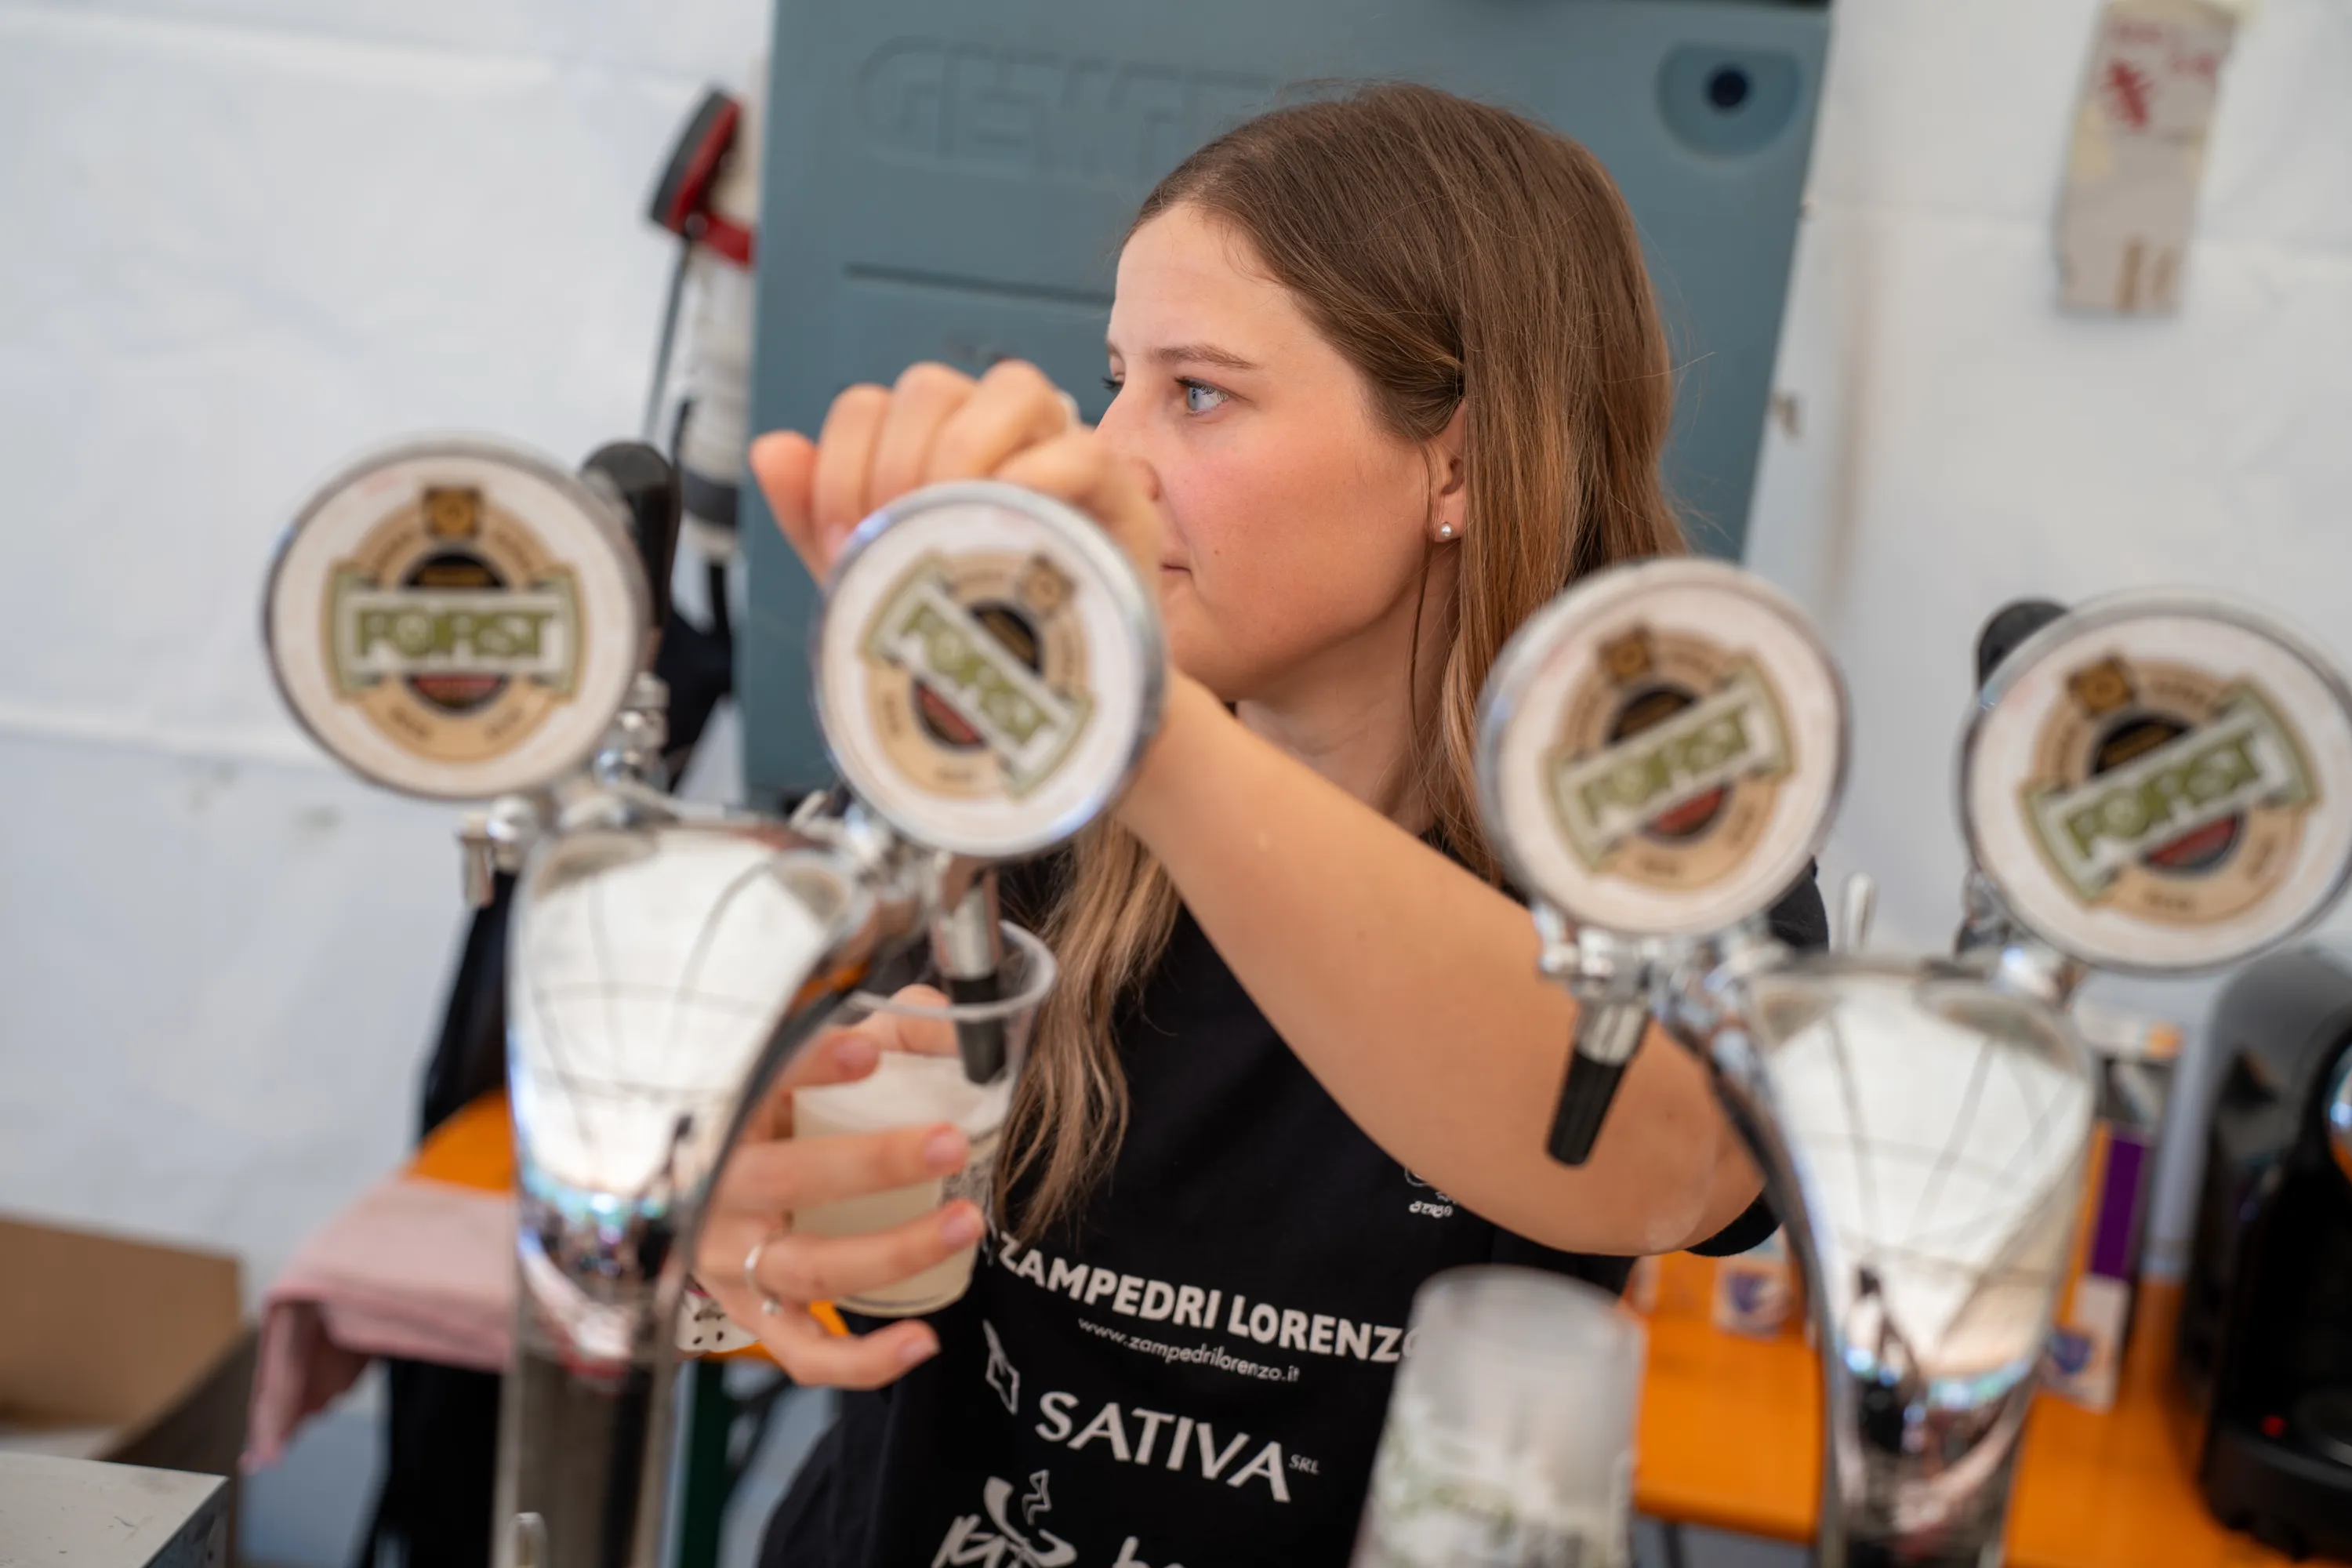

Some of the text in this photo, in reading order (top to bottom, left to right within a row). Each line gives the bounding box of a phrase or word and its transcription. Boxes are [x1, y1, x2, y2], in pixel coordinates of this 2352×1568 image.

[1000, 1230, 1222, 1330] ZAMPEDRI
[1077, 1317, 1301, 1382] www.zampedrilorenzo.it
[1035, 1391, 1319, 1503] SATIVA SRL
